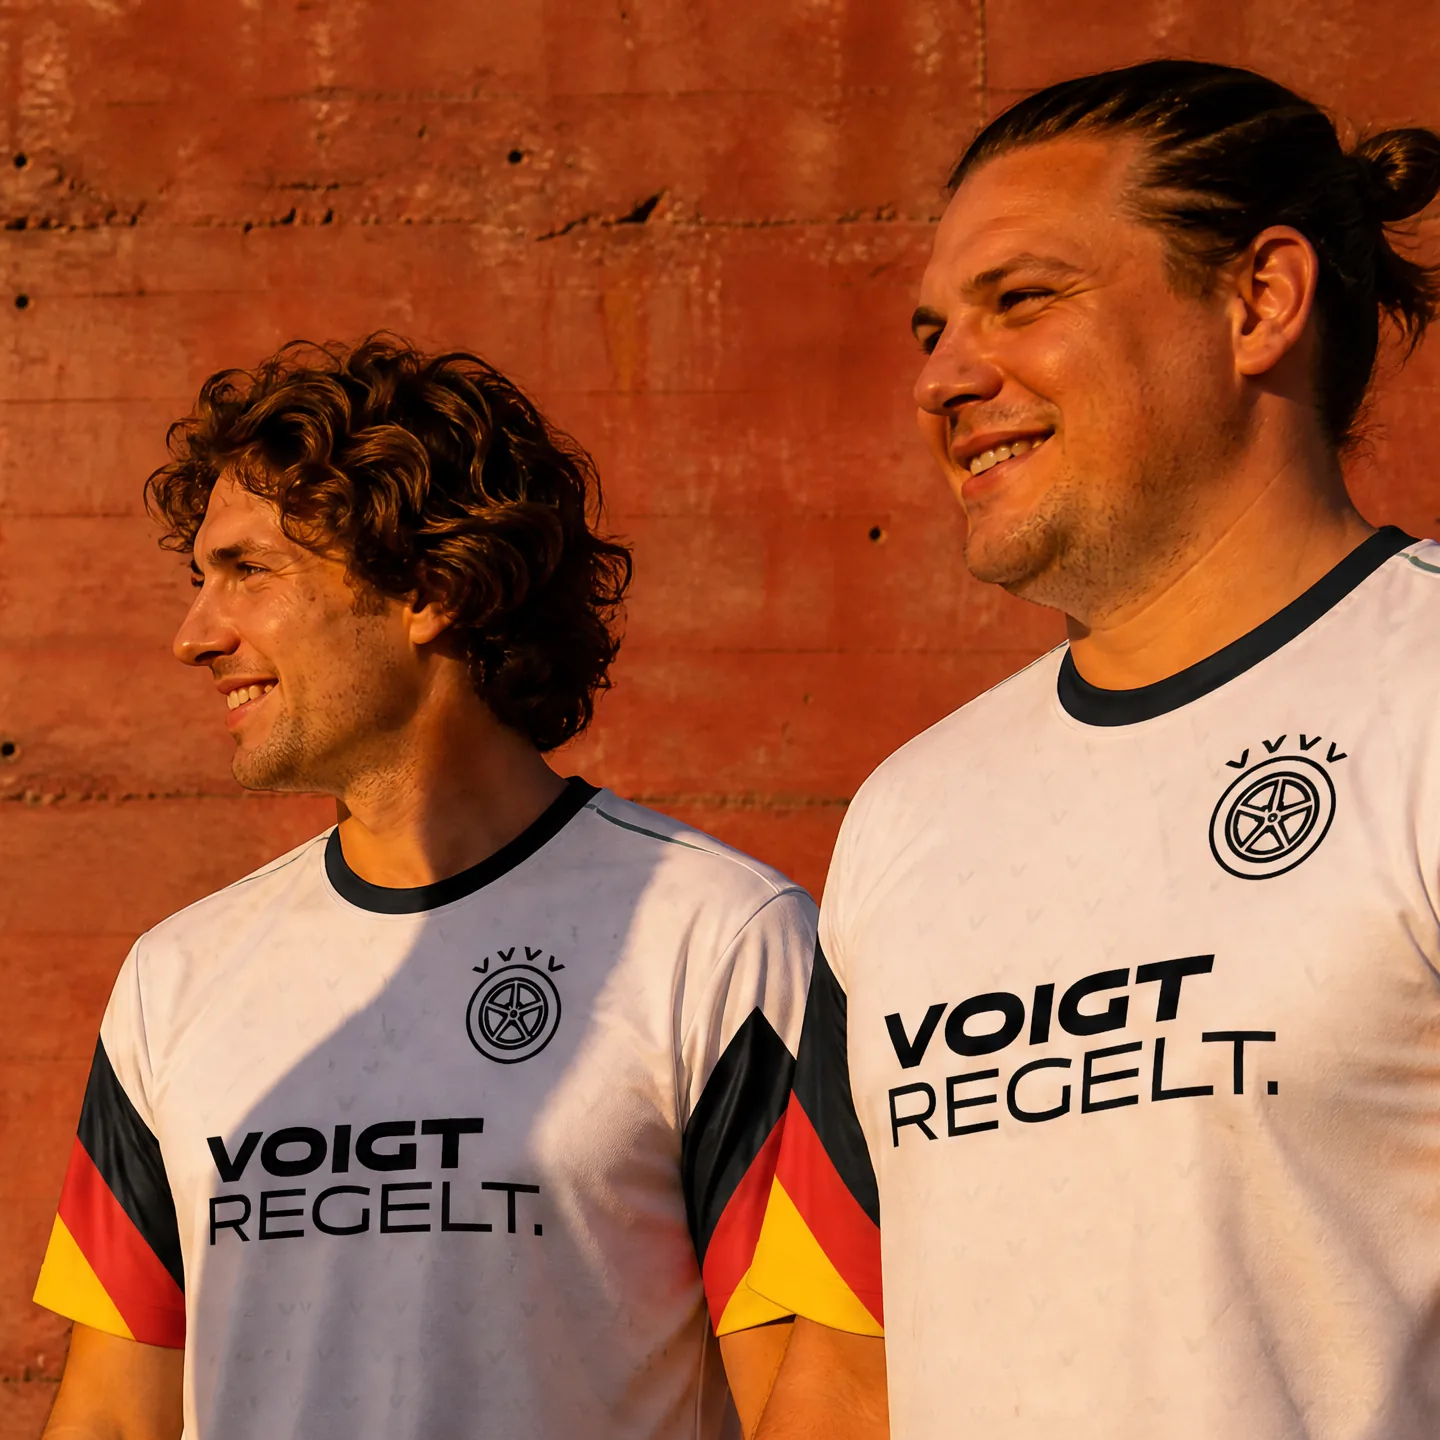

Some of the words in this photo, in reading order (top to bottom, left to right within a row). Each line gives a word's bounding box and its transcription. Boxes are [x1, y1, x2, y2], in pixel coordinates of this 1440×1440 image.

[884, 954, 1215, 1069] VOIGT
[888, 1031, 1279, 1148] REGELT.
[207, 1118, 484, 1182] VOIGT
[209, 1181, 543, 1246] REGELT.
